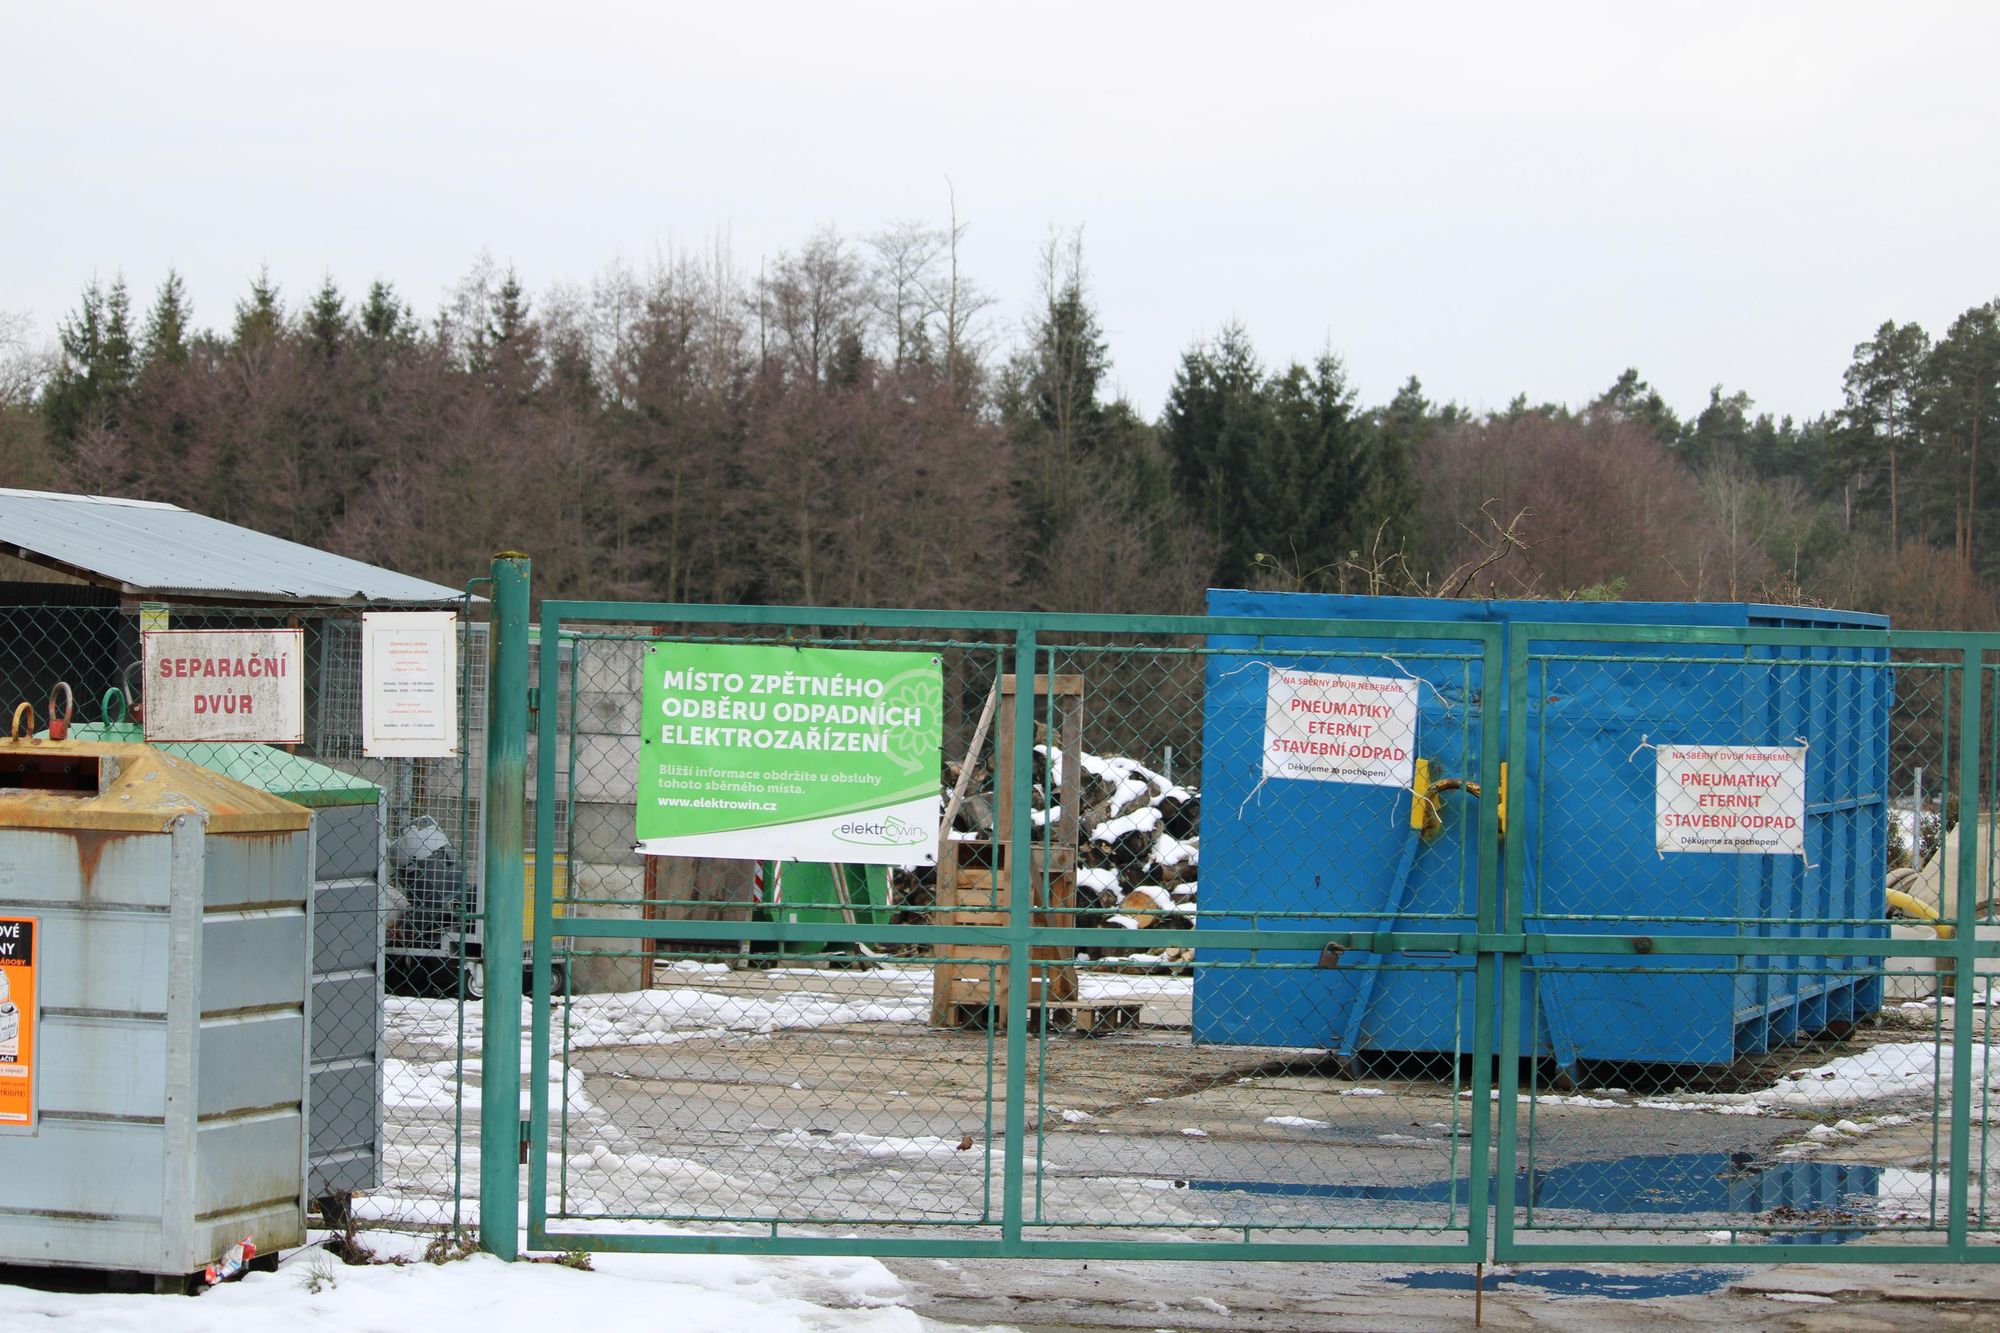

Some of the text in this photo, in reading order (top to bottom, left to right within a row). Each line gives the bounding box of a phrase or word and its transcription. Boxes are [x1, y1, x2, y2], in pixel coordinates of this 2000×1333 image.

[160, 652, 287, 677] SEPARAČNÍ
[663, 667, 884, 698] MÍSTO ZPĚTNÉHO
[1283, 676, 1296, 684] NA
[1358, 682, 1403, 693] NEBEREME
[194, 688, 253, 714] DVŮR
[1291, 699, 1392, 718] PNEUMATIKY
[662, 696, 921, 727] ODBĚRU ODPADNÍCH
[1308, 721, 1372, 738] ETERNIT
[661, 725, 890, 753] ELEKTROZAŘÍZENÍ
[1272, 739, 1405, 761] STAVEBNÍ ODPAD
[1672, 751, 1685, 759] NA
[1746, 753, 1791, 761] NEBEREME
[659, 764, 882, 786] Bližší informace obdržíte u obsluhy
[1288, 763, 1329, 773] Děkujeme
[1341, 767, 1387, 778] pochopení
[658, 778, 806, 795] tohoto sběrného místa.
[1681, 773, 1782, 787] PNEUMATIKY
[657, 796, 778, 811] www.elektrowin.cz
[1699, 794, 1762, 808] ETERNIT
[841, 821, 923, 837] elektrowin
[1665, 813, 1796, 829] STAVEBNÍ ODPAD
[1681, 837, 1722, 846] Děkujeme
[1734, 838, 1779, 847] pochopení
